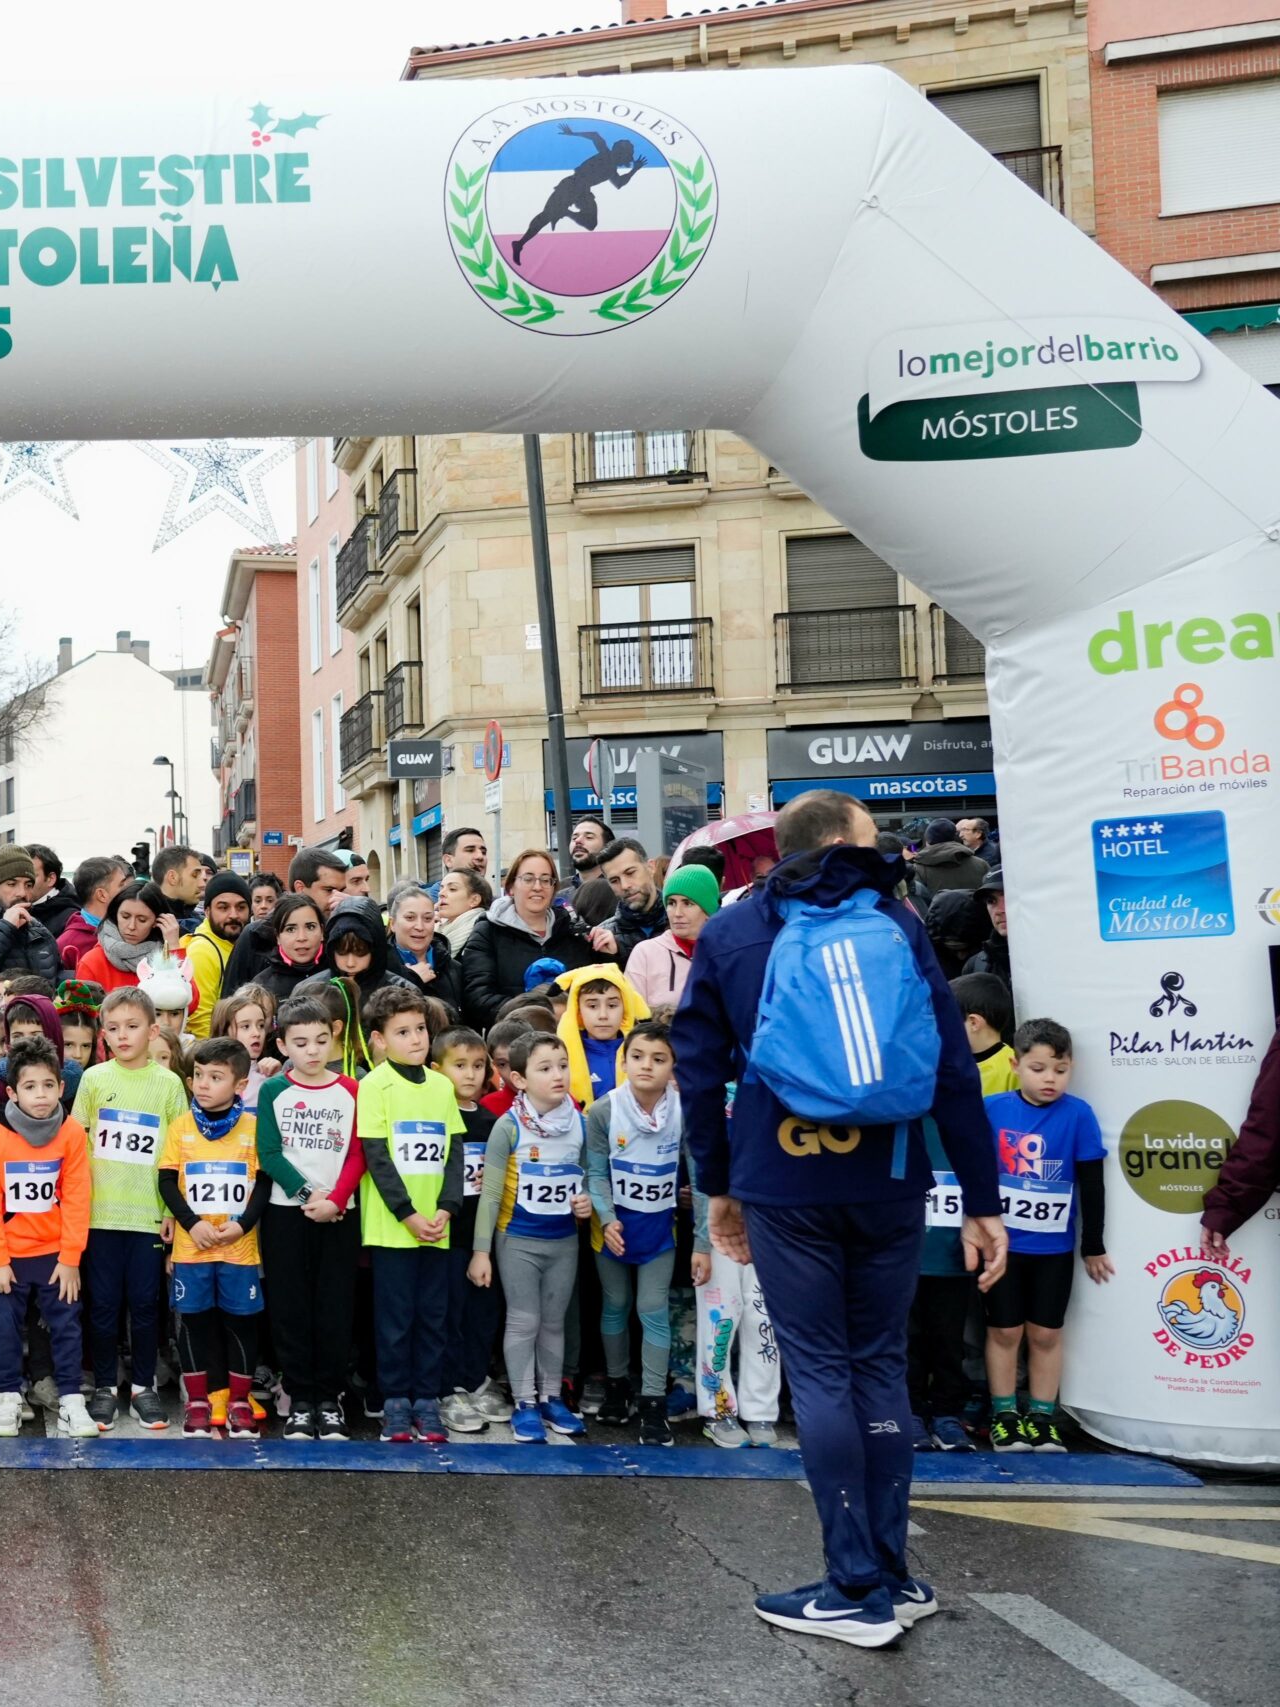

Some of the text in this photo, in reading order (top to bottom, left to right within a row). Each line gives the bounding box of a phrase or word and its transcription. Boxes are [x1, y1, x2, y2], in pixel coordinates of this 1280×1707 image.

[523, 99, 684, 146] MOSTOLES
[898, 333, 1180, 378] lomejordelbarrio
[921, 405, 1079, 440] MÓSTOLES
[1088, 610, 1280, 675] drea
[808, 734, 912, 765] GUAW
[923, 738, 977, 751] Disfruta,
[396, 753, 434, 765] GUAW
[1117, 749, 1271, 782] TriBanda
[870, 776, 968, 796] mascotas
[1123, 777, 1268, 798] Reparación de móviles
[1102, 839, 1169, 858] HOTEL
[1109, 894, 1192, 912] Ciudad de
[1108, 908, 1228, 933] Móstoles
[1109, 1031, 1164, 1056] Pilar
[1200, 1056, 1213, 1064] DE
[1216, 1055, 1257, 1064] BELLEZA
[295, 1108, 344, 1123] NAUGHTY
[293, 1122, 323, 1135] NICE
[777, 1117, 861, 1157] GO
[98, 1129, 155, 1154] 1182
[299, 1137, 333, 1150] TRIED
[1144, 1132, 1223, 1149] La vida a
[8, 1181, 54, 1201] 130
[188, 1183, 246, 1202] 1210
[522, 1182, 577, 1203] 1251
[616, 1178, 674, 1201] 1252
[1160, 1184, 1204, 1192] MÓSTOLES
[1001, 1196, 1068, 1221] 1287
[1152, 1328, 1254, 1369] DE PEDRO
[1154, 1375, 1187, 1383] Mercado
[1210, 1378, 1261, 1387] Constitución
[1167, 1385, 1194, 1393] Puesto
